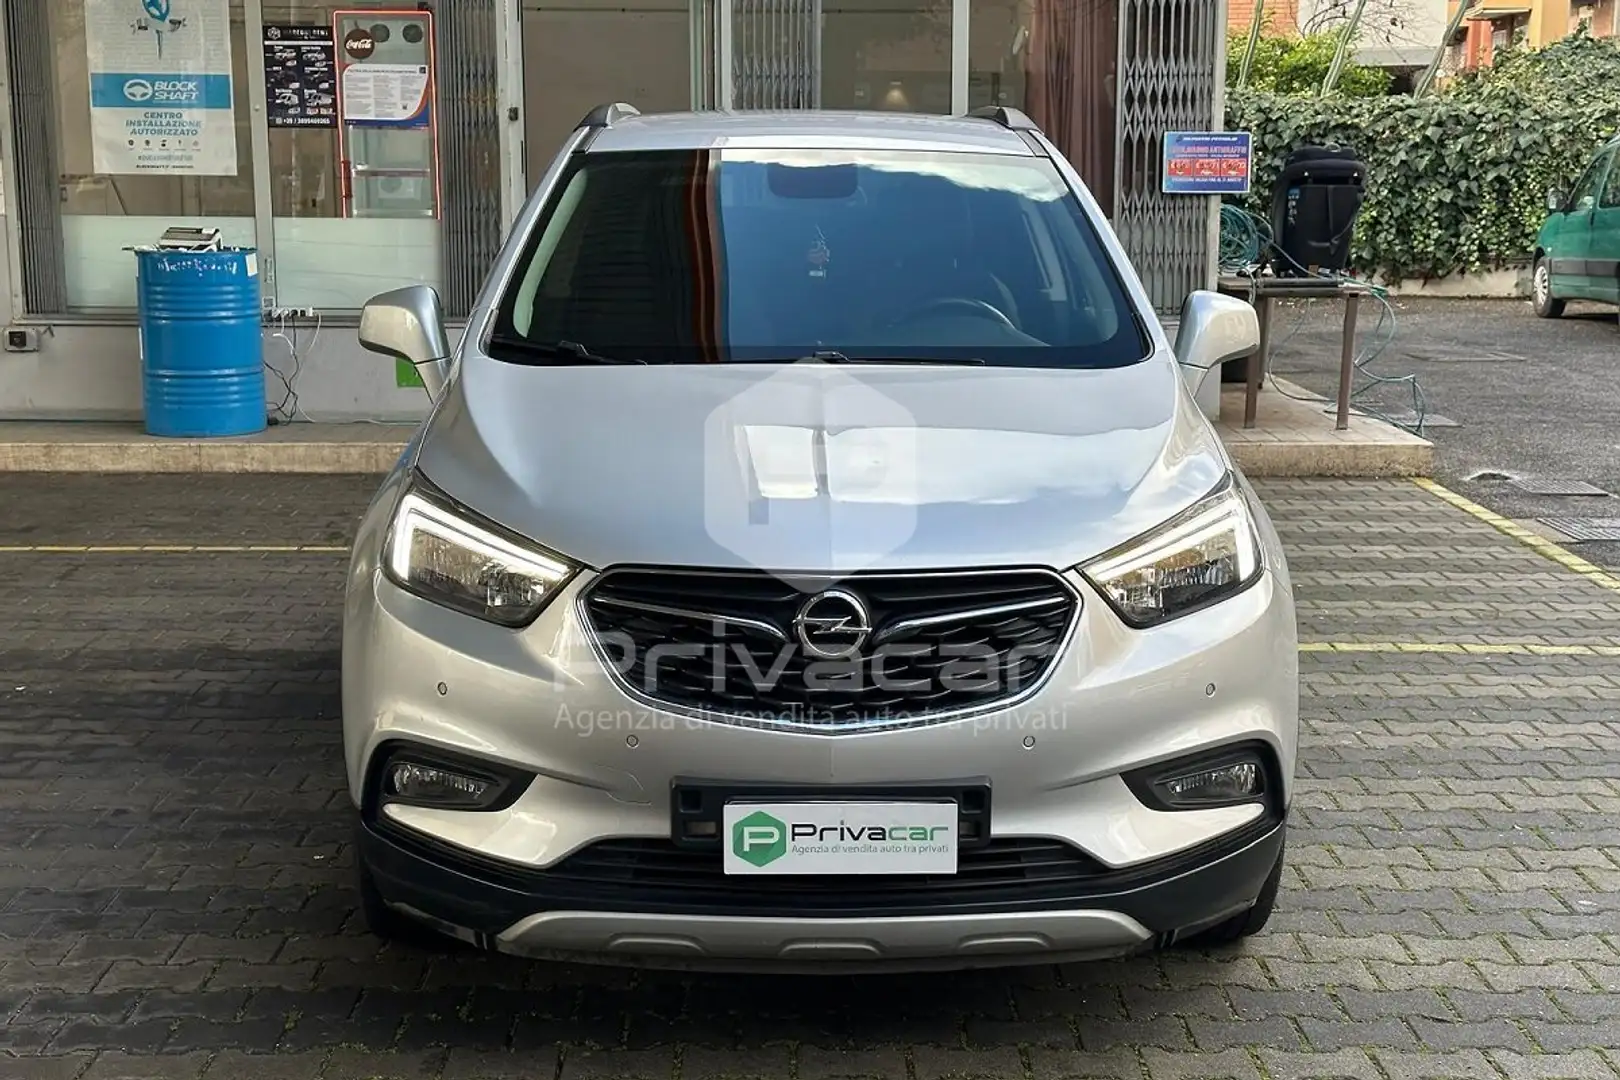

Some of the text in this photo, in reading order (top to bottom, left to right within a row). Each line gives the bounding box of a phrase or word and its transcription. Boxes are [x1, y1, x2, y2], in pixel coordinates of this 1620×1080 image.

[154, 80, 197, 91] BLOCK
[154, 91, 199, 100] SHAFT
[143, 111, 183, 119] CENTRO
[126, 119, 202, 128] INSTALLAZIONE
[130, 128, 198, 136] AUTORIZZATO
[791, 820, 949, 842] Privacar
[792, 844, 949, 856] Agenzia di vendita auto tra privati
